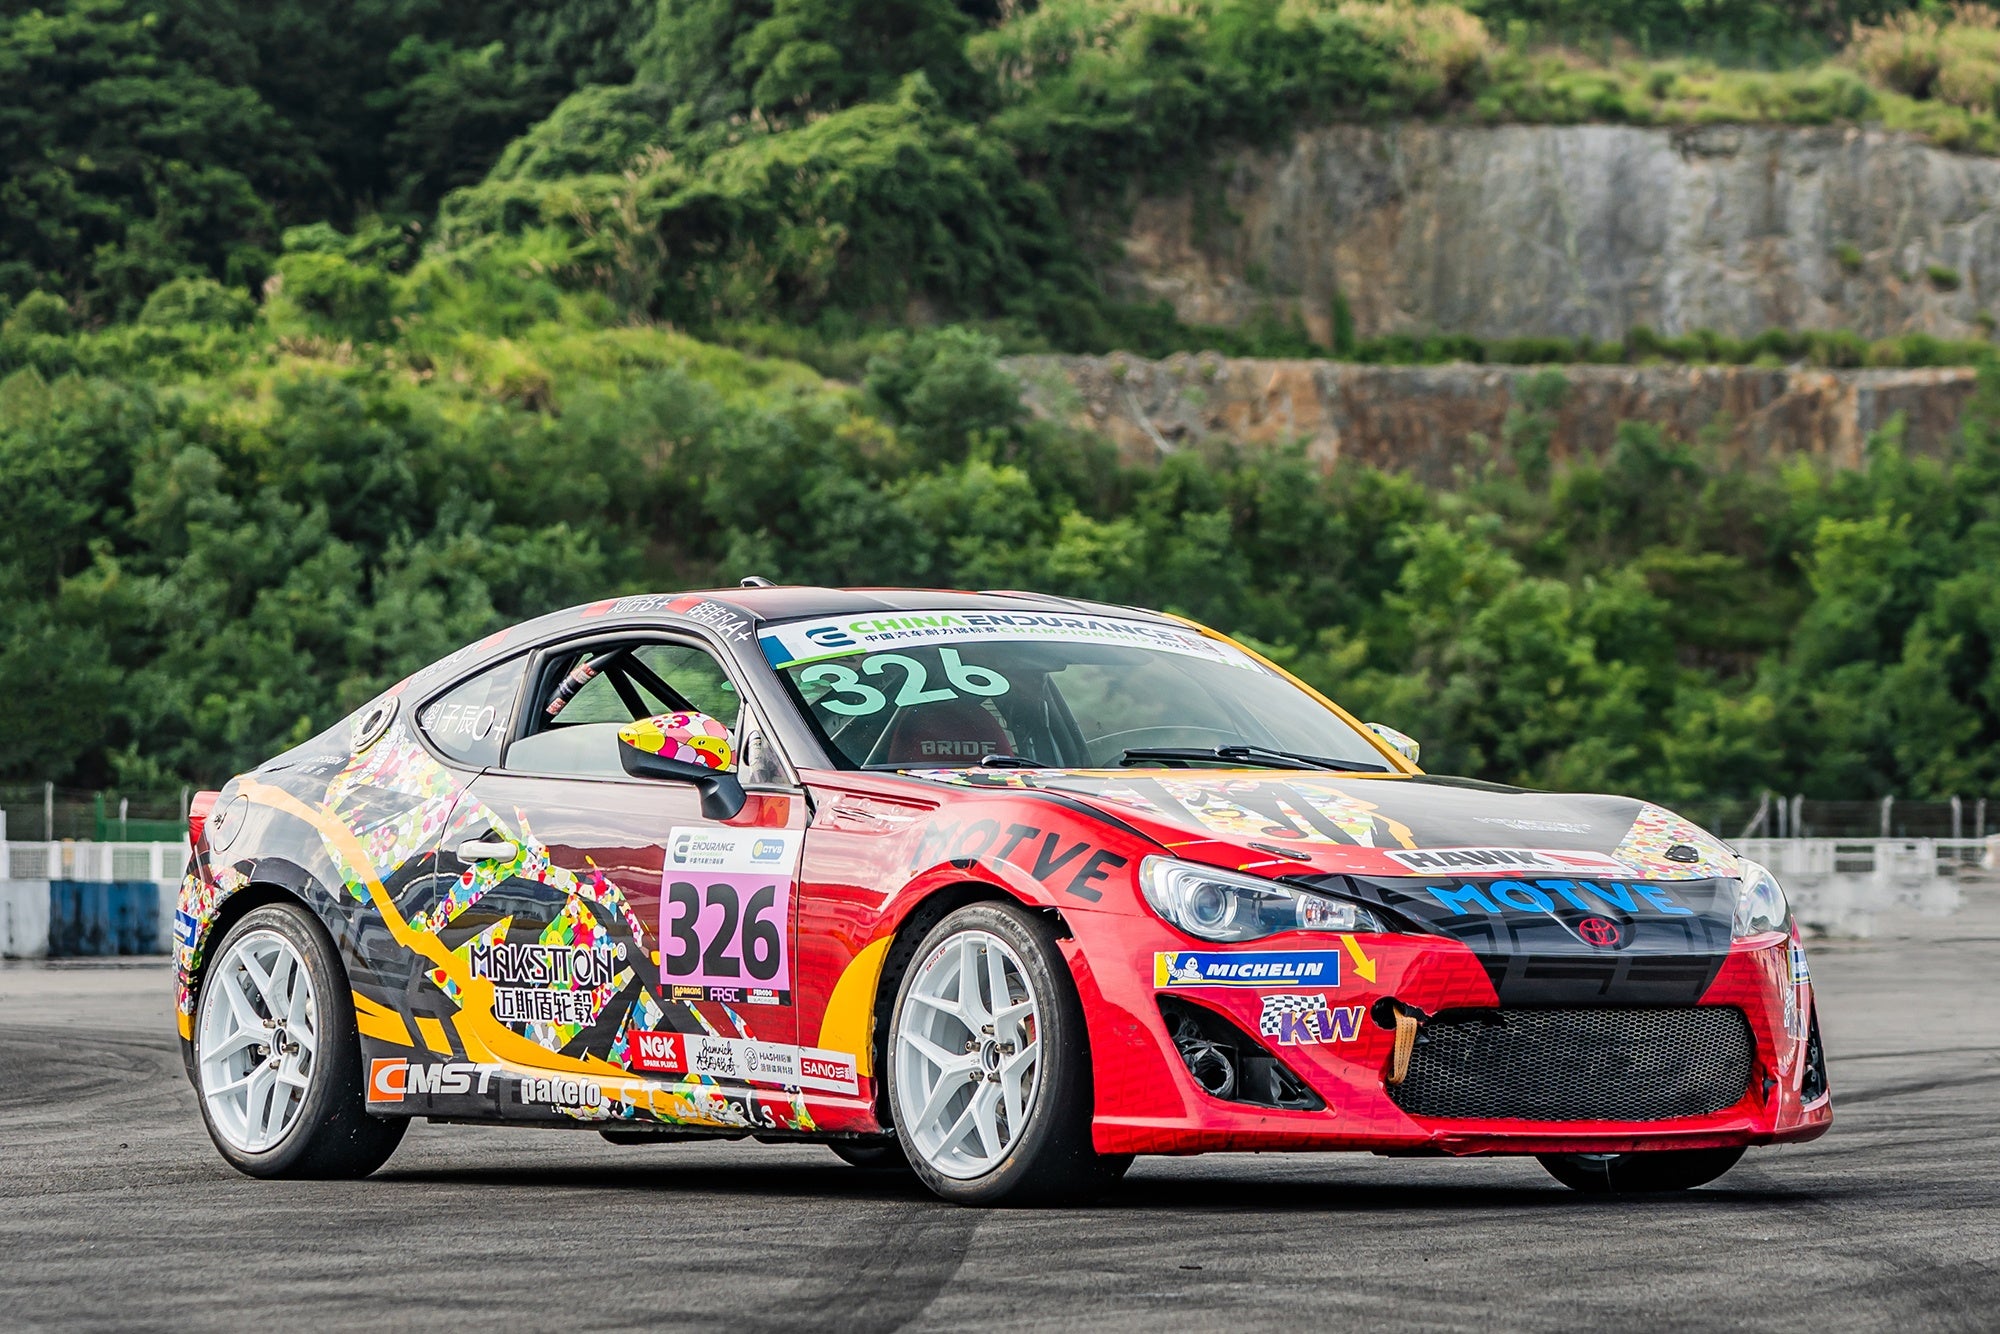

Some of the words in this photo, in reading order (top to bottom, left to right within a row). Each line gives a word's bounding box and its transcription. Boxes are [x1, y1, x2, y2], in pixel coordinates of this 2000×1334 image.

[848, 615, 967, 634] CHINA
[961, 614, 1183, 643] ENDURANCE
[799, 648, 1011, 716] 326
[920, 740, 997, 756] BRIDE
[691, 842, 735, 852] ENDURANCE
[910, 818, 1129, 904] MOTVE
[1393, 850, 1554, 868] HAWK
[1425, 879, 1694, 916] MOTVE
[666, 882, 781, 981] 326
[1206, 962, 1324, 978] MICHELIN
[494, 987, 595, 1027] 迈斯盾轮毂
[1278, 1007, 1367, 1045] KW
[638, 1035, 677, 1060] NGK
[375, 1063, 501, 1096] CMST
[643, 1059, 660, 1068] SPARK
[661, 1061, 678, 1069] PLUGS
[521, 1077, 602, 1108] pakelo
